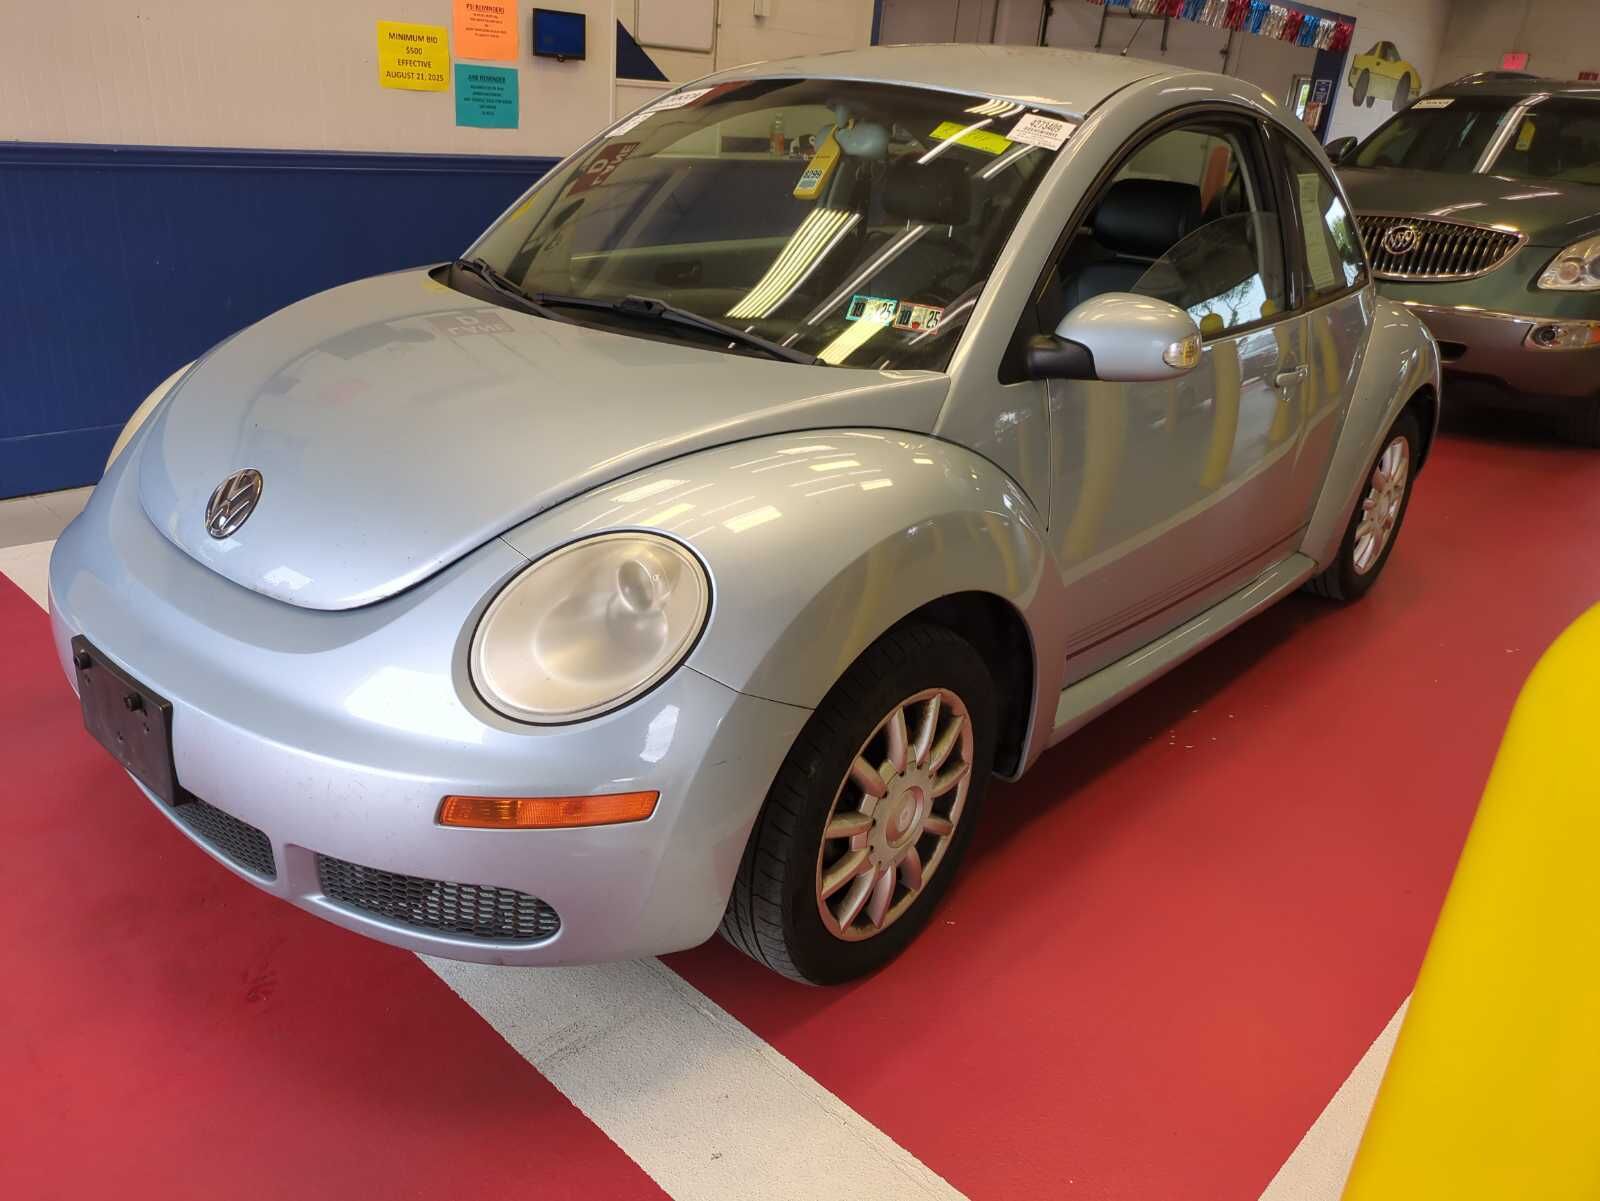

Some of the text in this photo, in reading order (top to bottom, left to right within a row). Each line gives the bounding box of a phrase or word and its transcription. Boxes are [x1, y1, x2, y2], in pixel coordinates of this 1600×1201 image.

[388, 32, 438, 44] MINIMUM BID
[406, 46, 422, 55] $500
[397, 58, 432, 69] EFFECTIVE
[386, 70, 444, 82] AUGUST 21, 2025
[926, 311, 941, 328] 25
